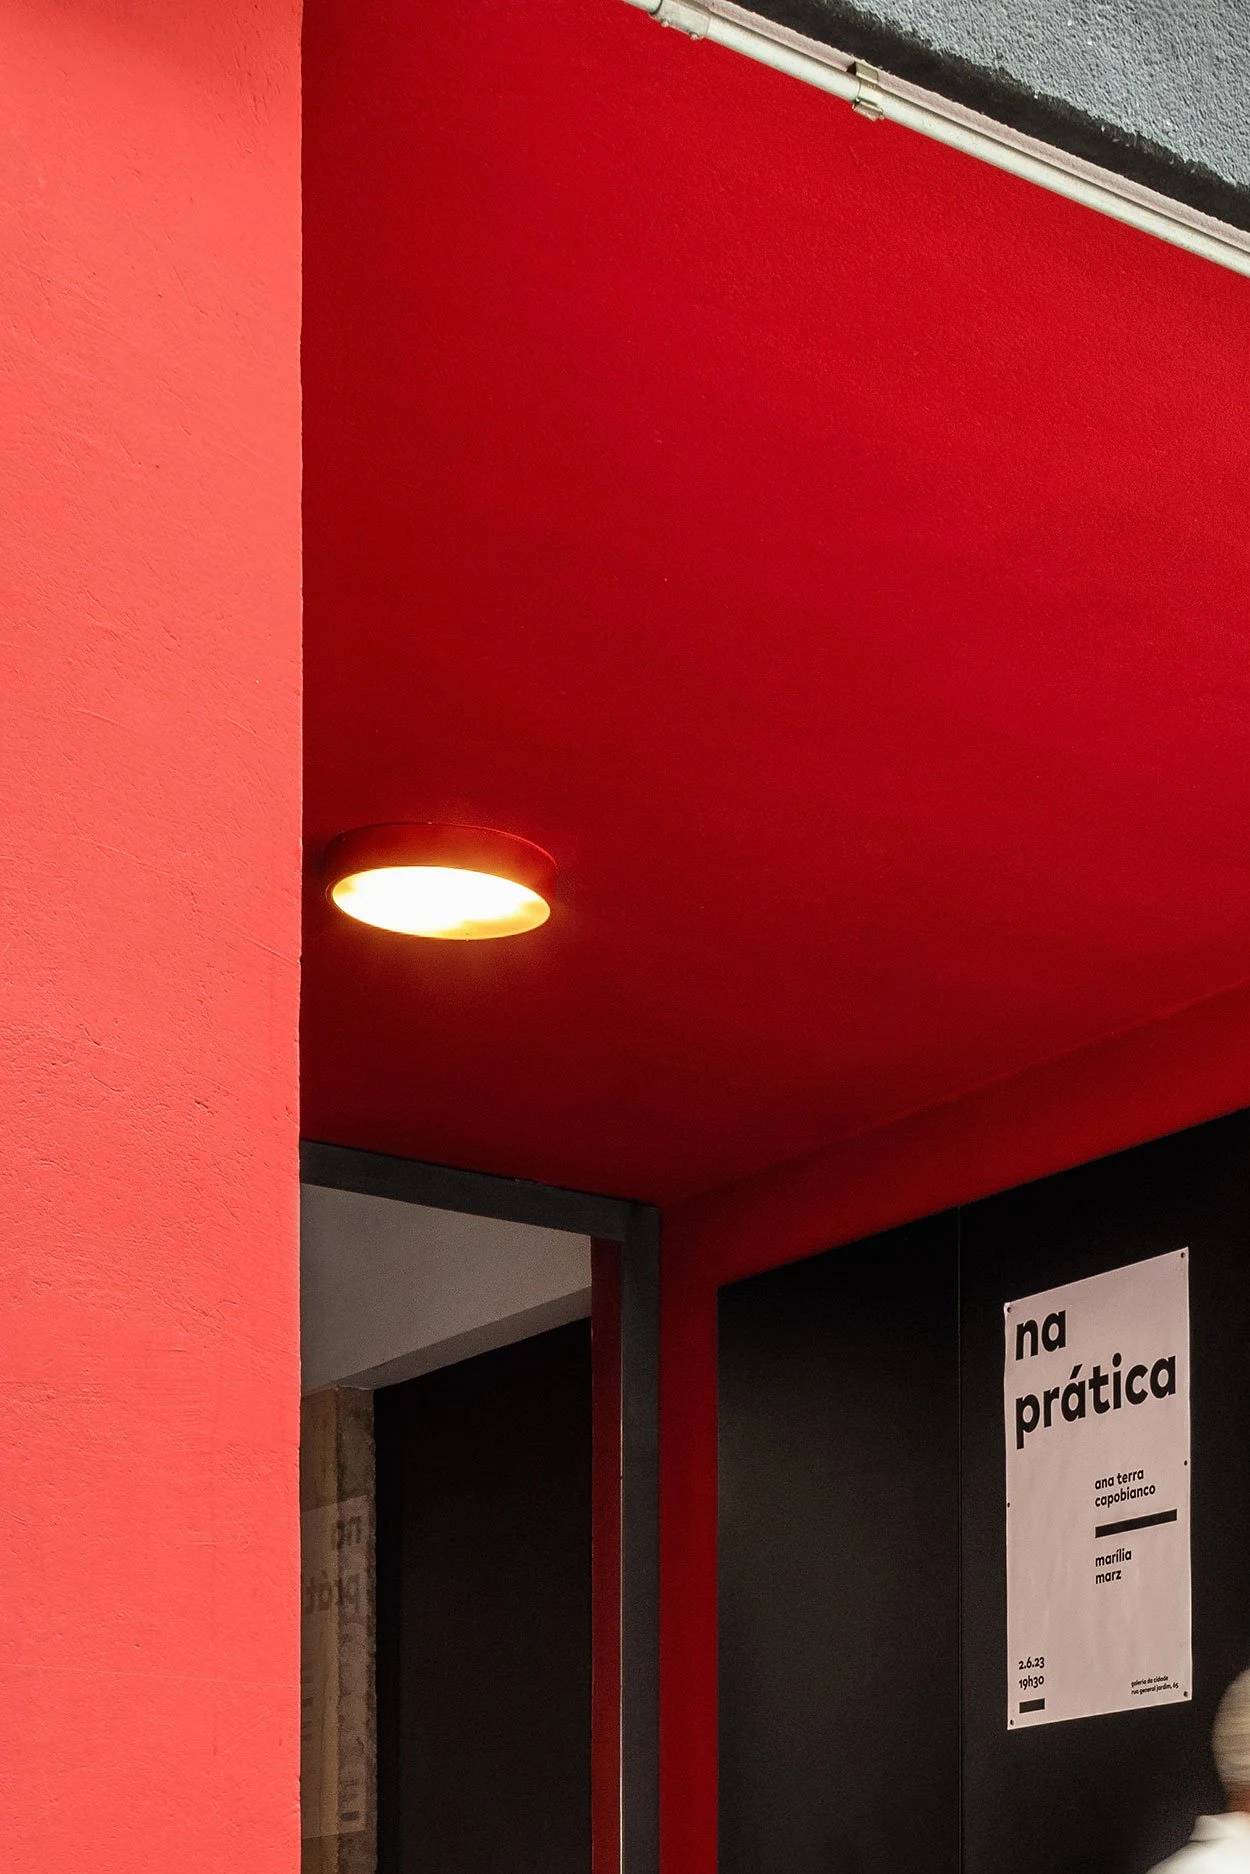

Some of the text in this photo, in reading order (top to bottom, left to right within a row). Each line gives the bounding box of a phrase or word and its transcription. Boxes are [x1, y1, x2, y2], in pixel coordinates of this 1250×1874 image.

[1015, 1310, 1067, 1361] na
[1015, 1352, 1176, 1450] prática
[1095, 1469, 1144, 1490] ana terra
[1095, 1484, 1156, 1508] capobianco
[1095, 1547, 1132, 1567] marília
[1095, 1570, 1122, 1585] marz
[1018, 1657, 1045, 1670] 2.6.23
[1018, 1675, 1045, 1690] 19h30
[1154, 1675, 1169, 1683] cidade
